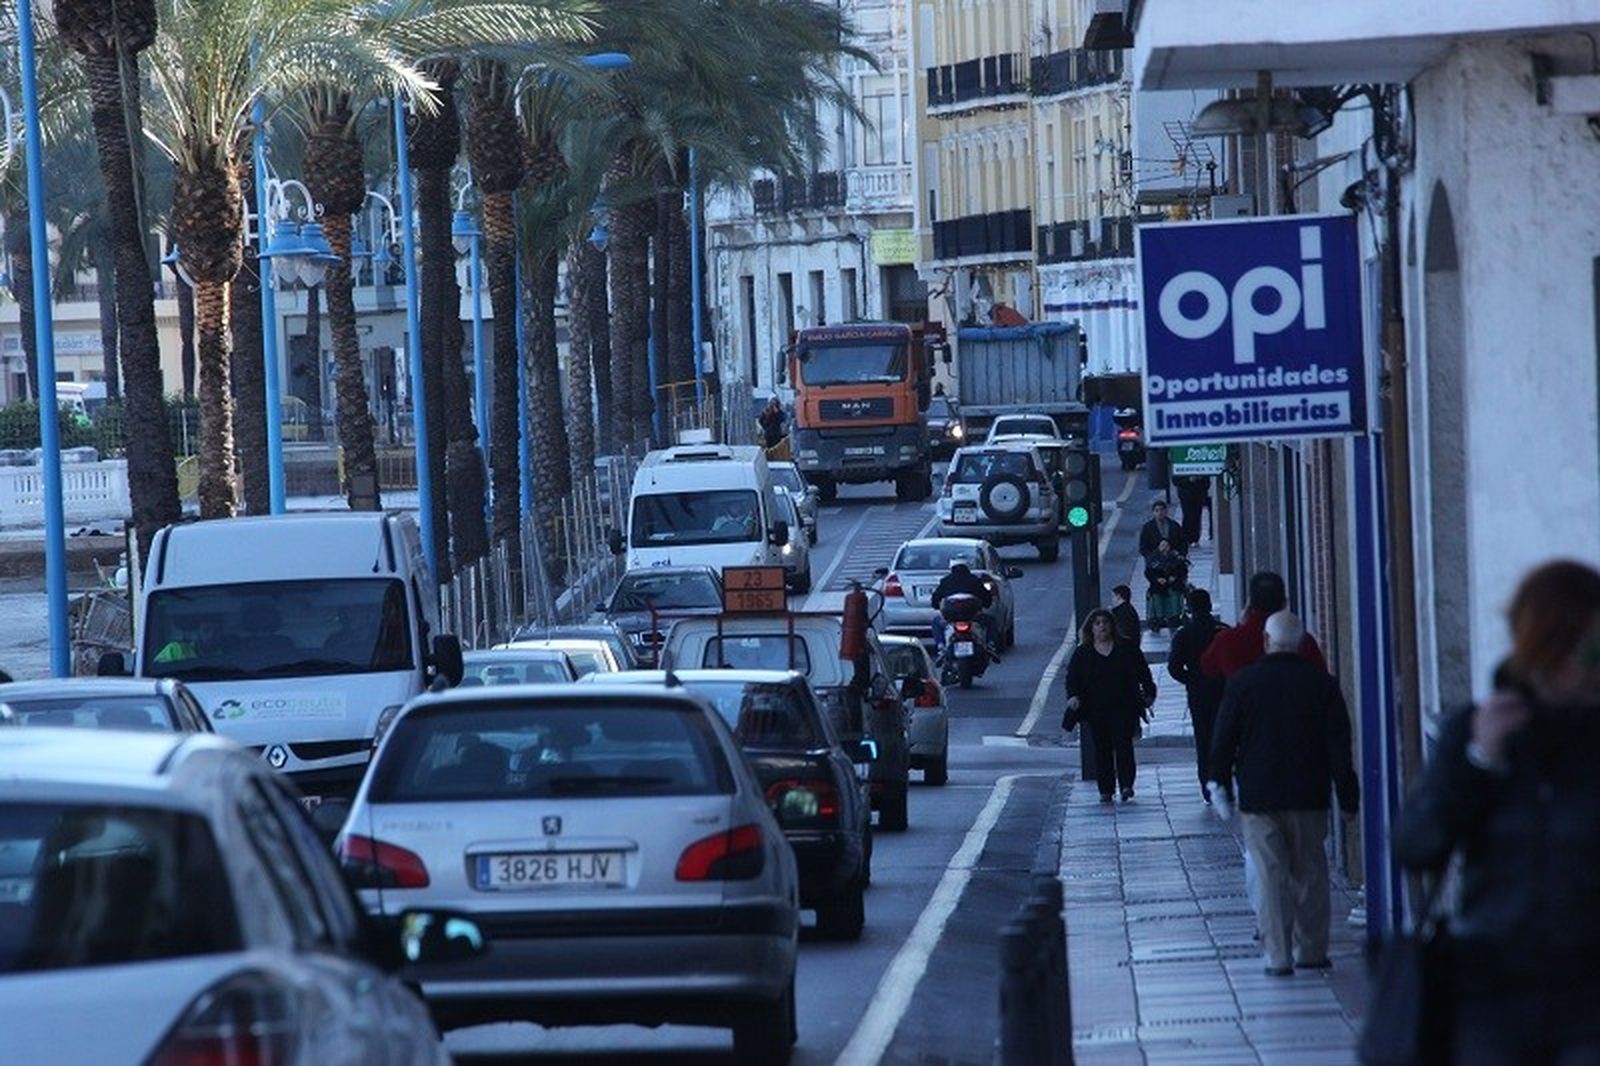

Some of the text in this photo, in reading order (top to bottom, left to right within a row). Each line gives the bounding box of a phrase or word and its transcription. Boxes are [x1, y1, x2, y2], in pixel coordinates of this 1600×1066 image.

[1159, 225, 1326, 364] opi
[1148, 363, 1349, 399] Oportunidades
[1155, 398, 1341, 430] Inmobiliarias
[743, 571, 762, 588] 23
[737, 592, 773, 609] 1965
[498, 855, 611, 882] 3826 HJV
